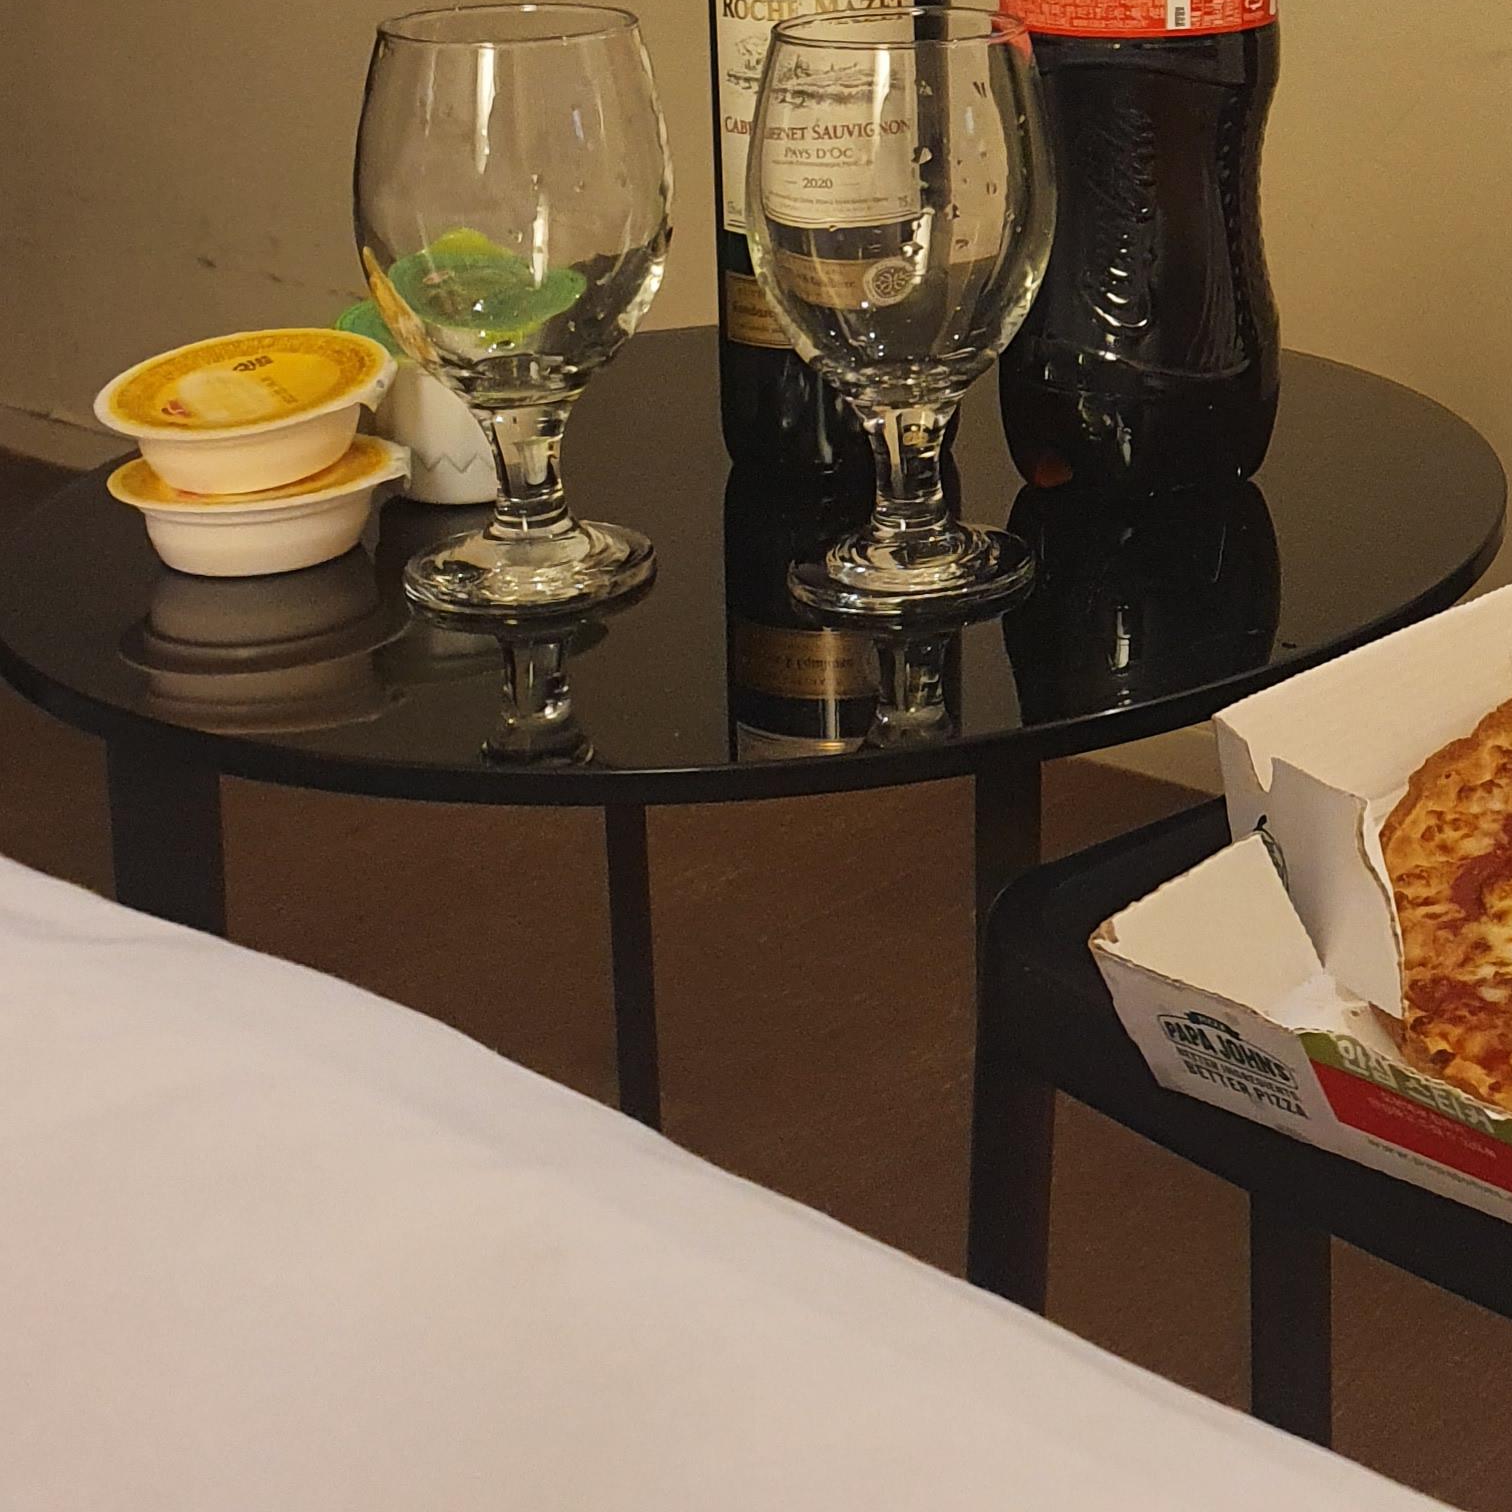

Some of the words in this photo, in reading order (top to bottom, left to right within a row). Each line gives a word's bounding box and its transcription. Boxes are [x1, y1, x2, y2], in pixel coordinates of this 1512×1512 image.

[784, 148, 811, 159] PAYS
[803, 178, 833, 189] 2020
[1164, 1021, 1217, 1054] PAPA
[1183, 1059, 1251, 1096] BETTER
